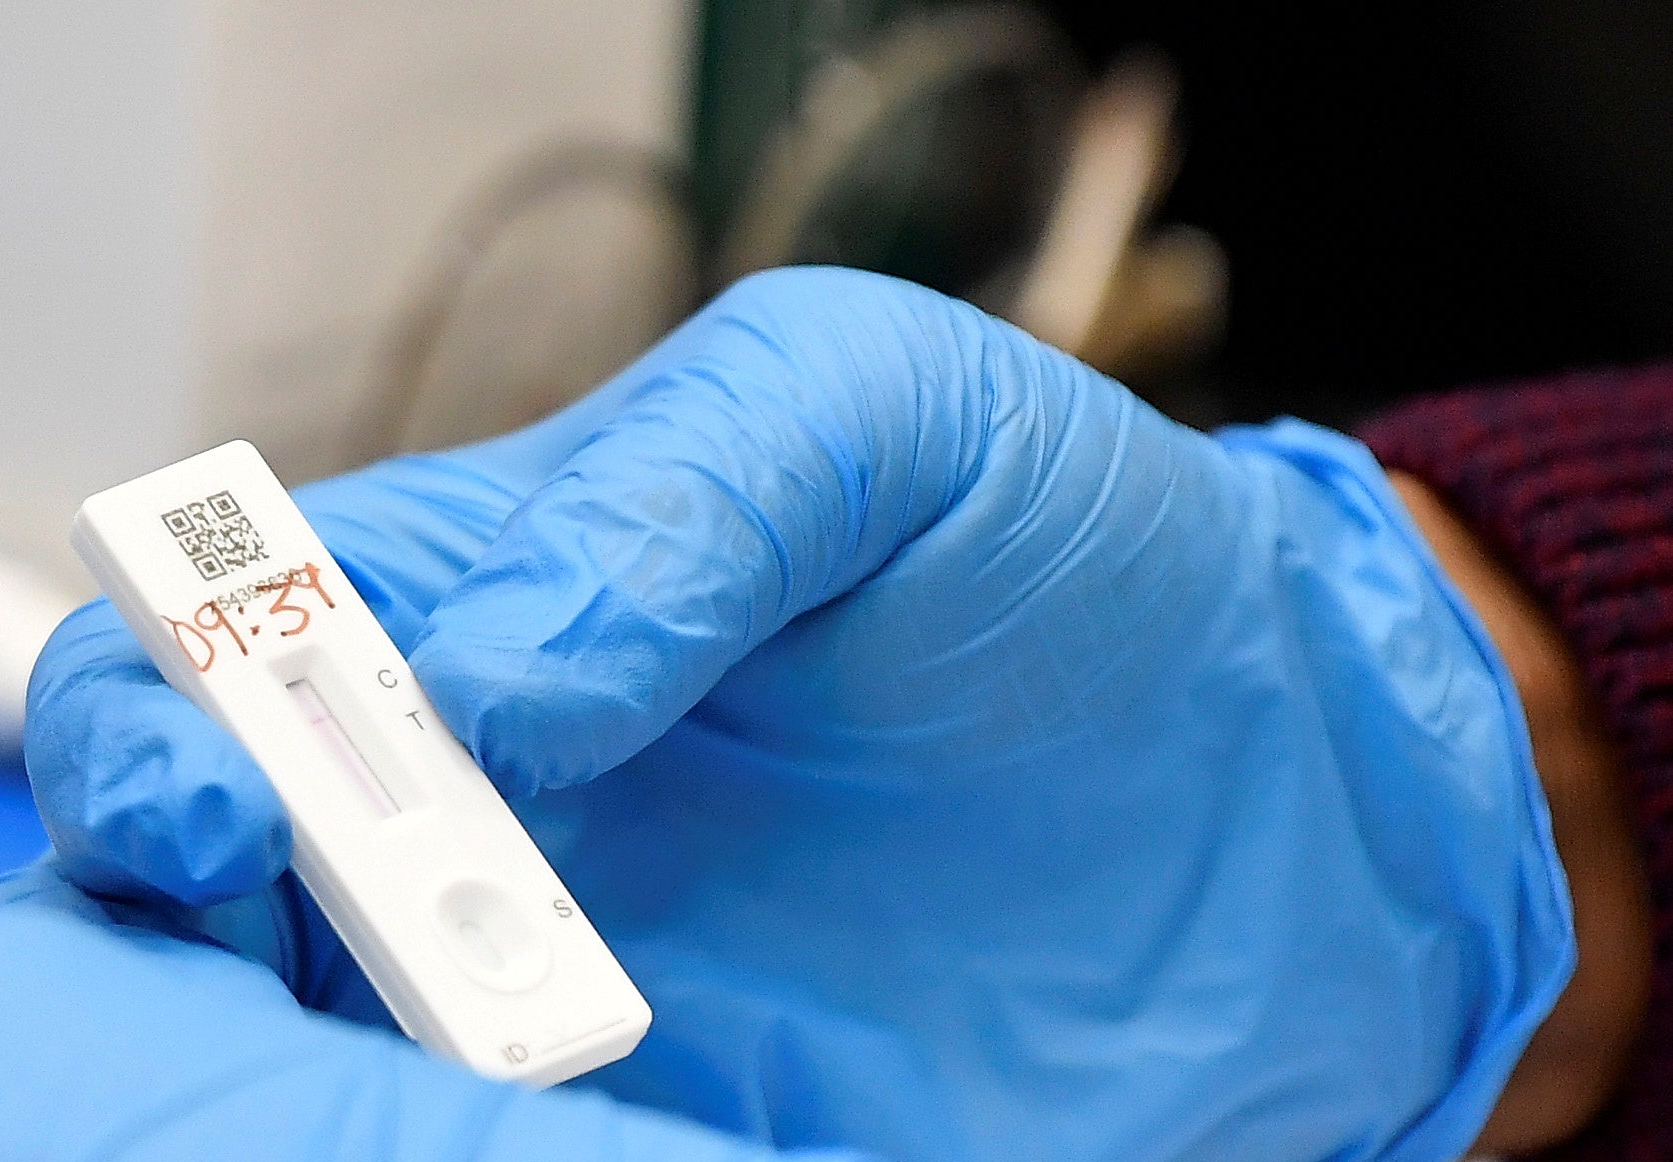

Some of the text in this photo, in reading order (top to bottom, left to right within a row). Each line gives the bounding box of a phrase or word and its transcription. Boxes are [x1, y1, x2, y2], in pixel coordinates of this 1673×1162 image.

[377, 669, 398, 689] C
[405, 710, 424, 730] T
[553, 899, 574, 919] S
[501, 1042, 529, 1065] ID
